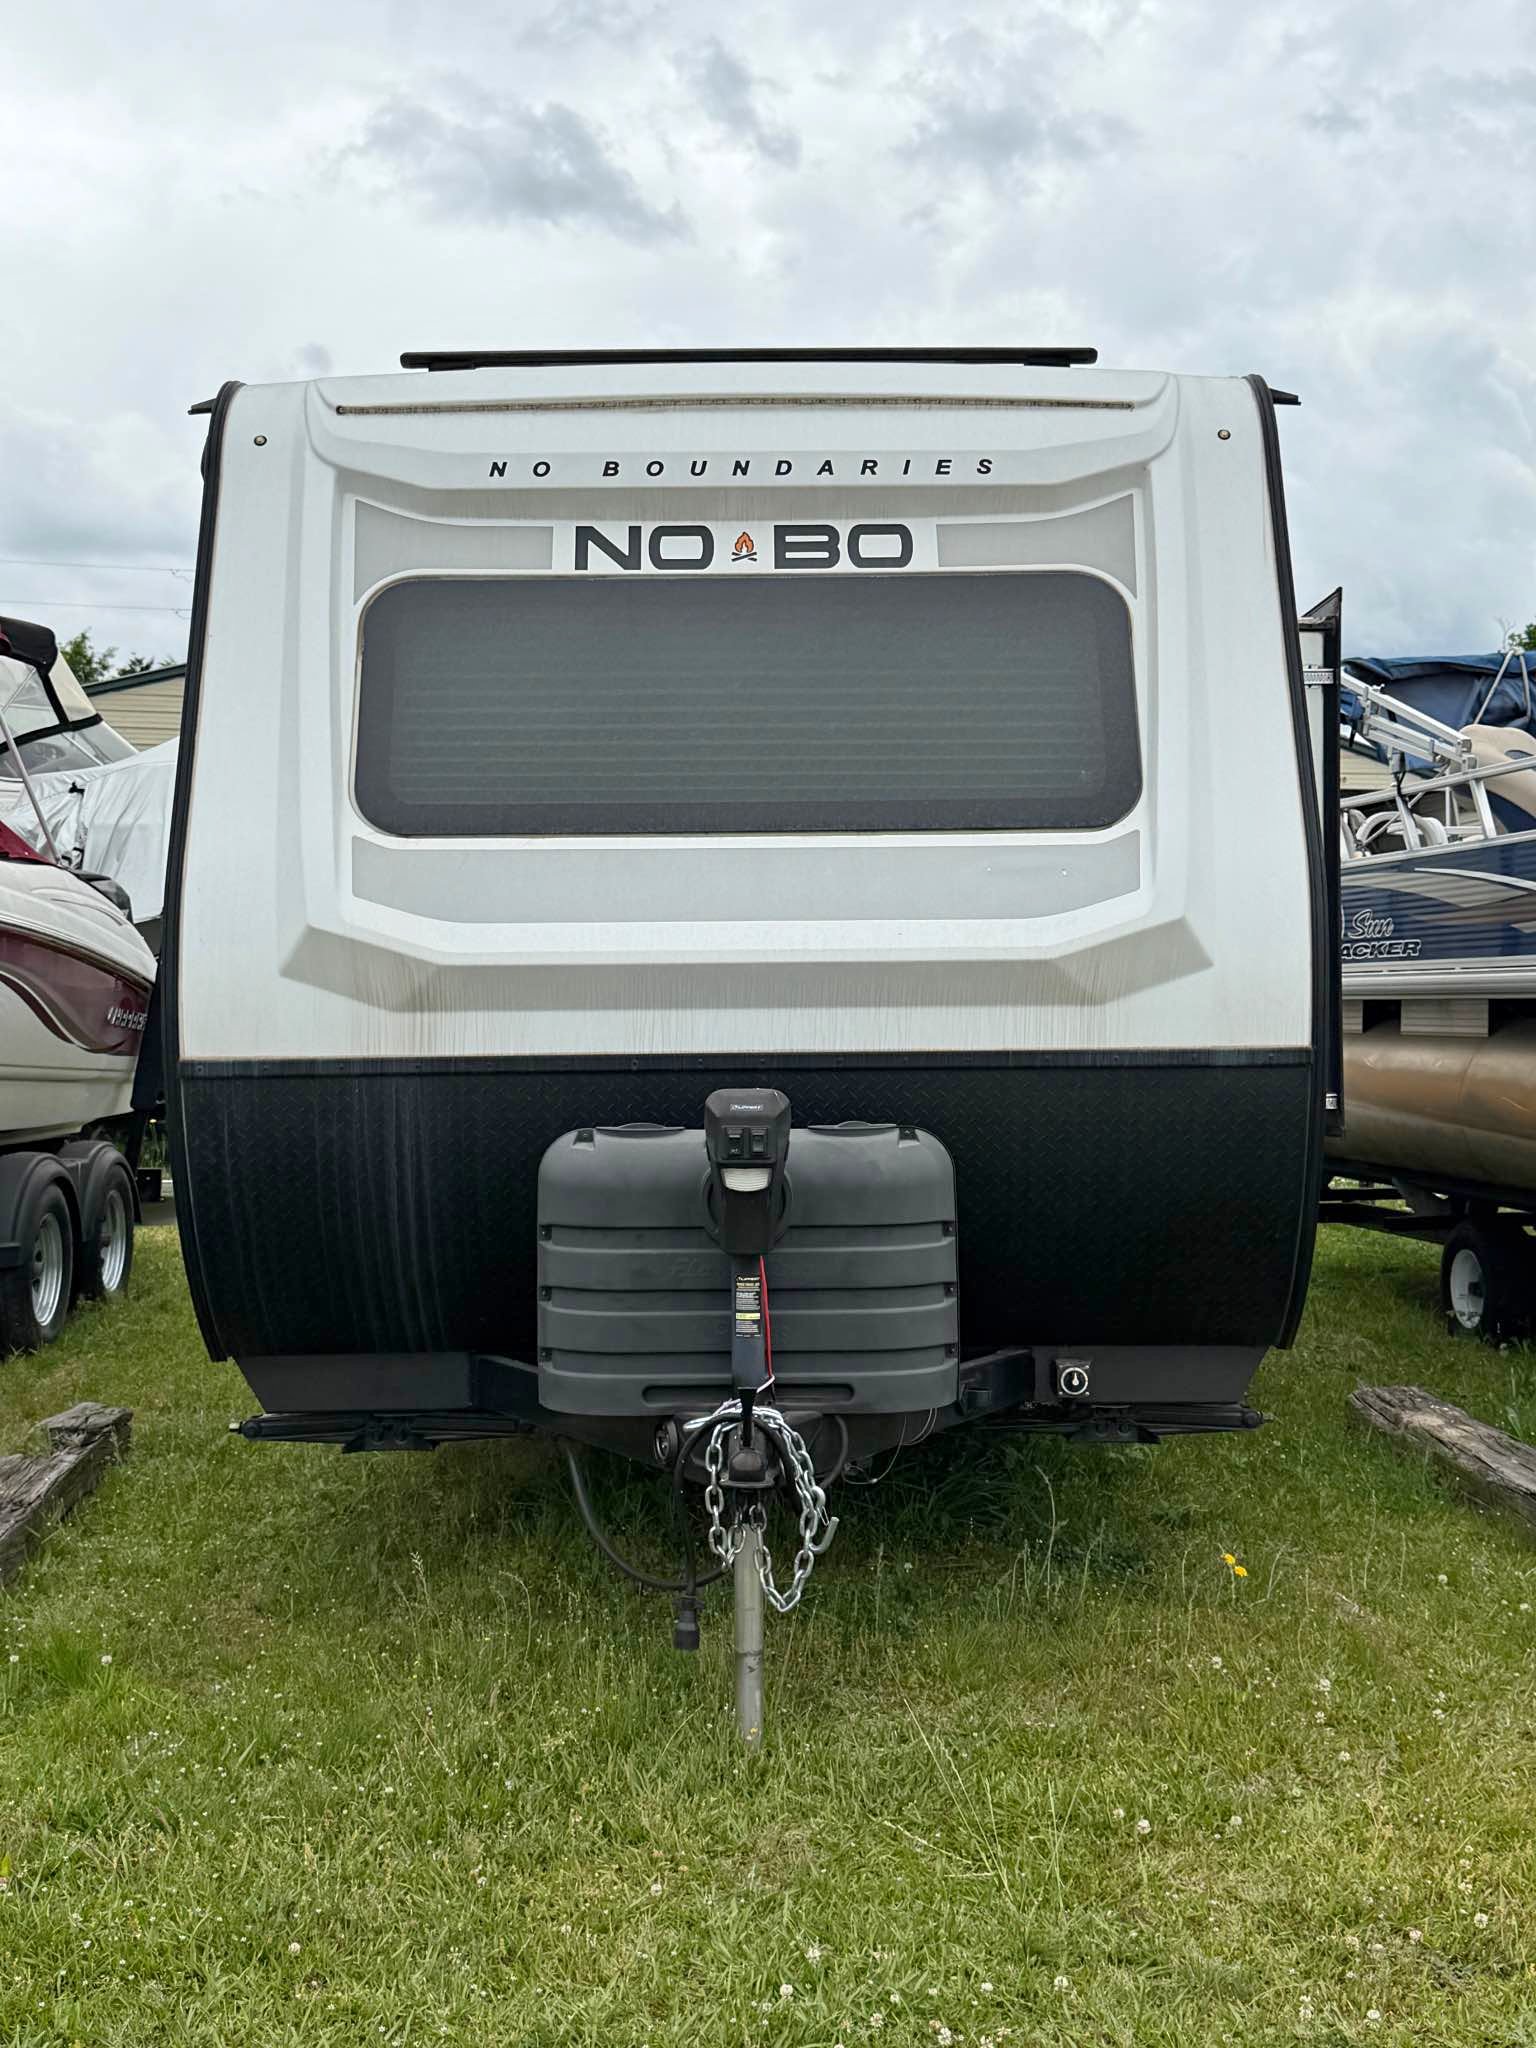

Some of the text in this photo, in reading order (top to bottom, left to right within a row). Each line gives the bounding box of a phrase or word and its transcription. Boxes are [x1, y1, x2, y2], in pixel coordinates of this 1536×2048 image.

[489, 459, 993, 478] NO BOUNDARIES
[574, 524, 913, 571] NO BO
[1347, 908, 1394, 939] Sun
[1341, 939, 1422, 959] ACKER
